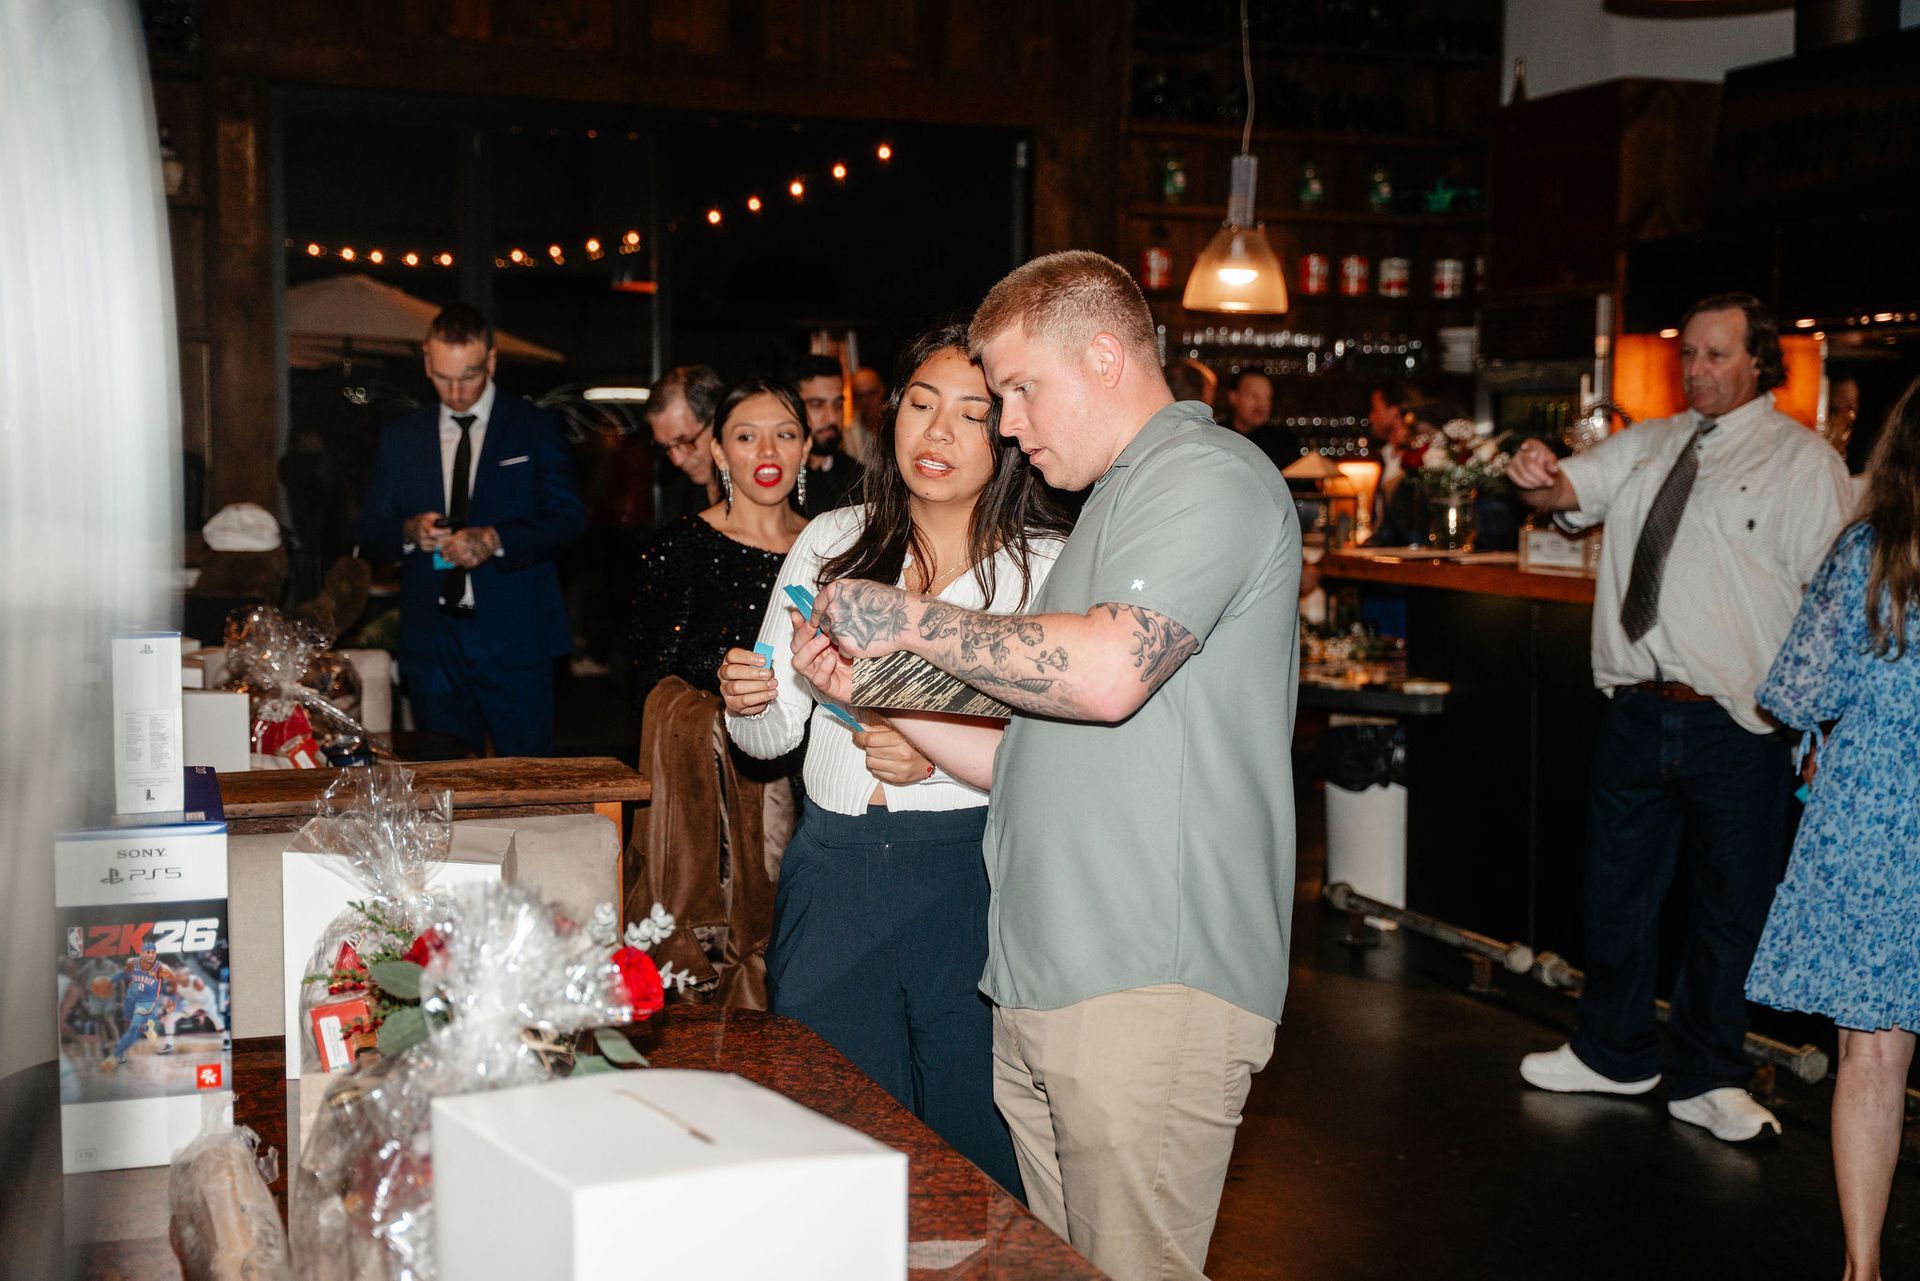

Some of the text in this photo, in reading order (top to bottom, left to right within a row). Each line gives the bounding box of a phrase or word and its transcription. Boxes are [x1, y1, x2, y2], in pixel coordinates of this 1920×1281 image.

[116, 848, 166, 859] SONY
[129, 867, 182, 881] PS5
[84, 918, 219, 957] 2K26
[200, 1069, 218, 1085] 2K
